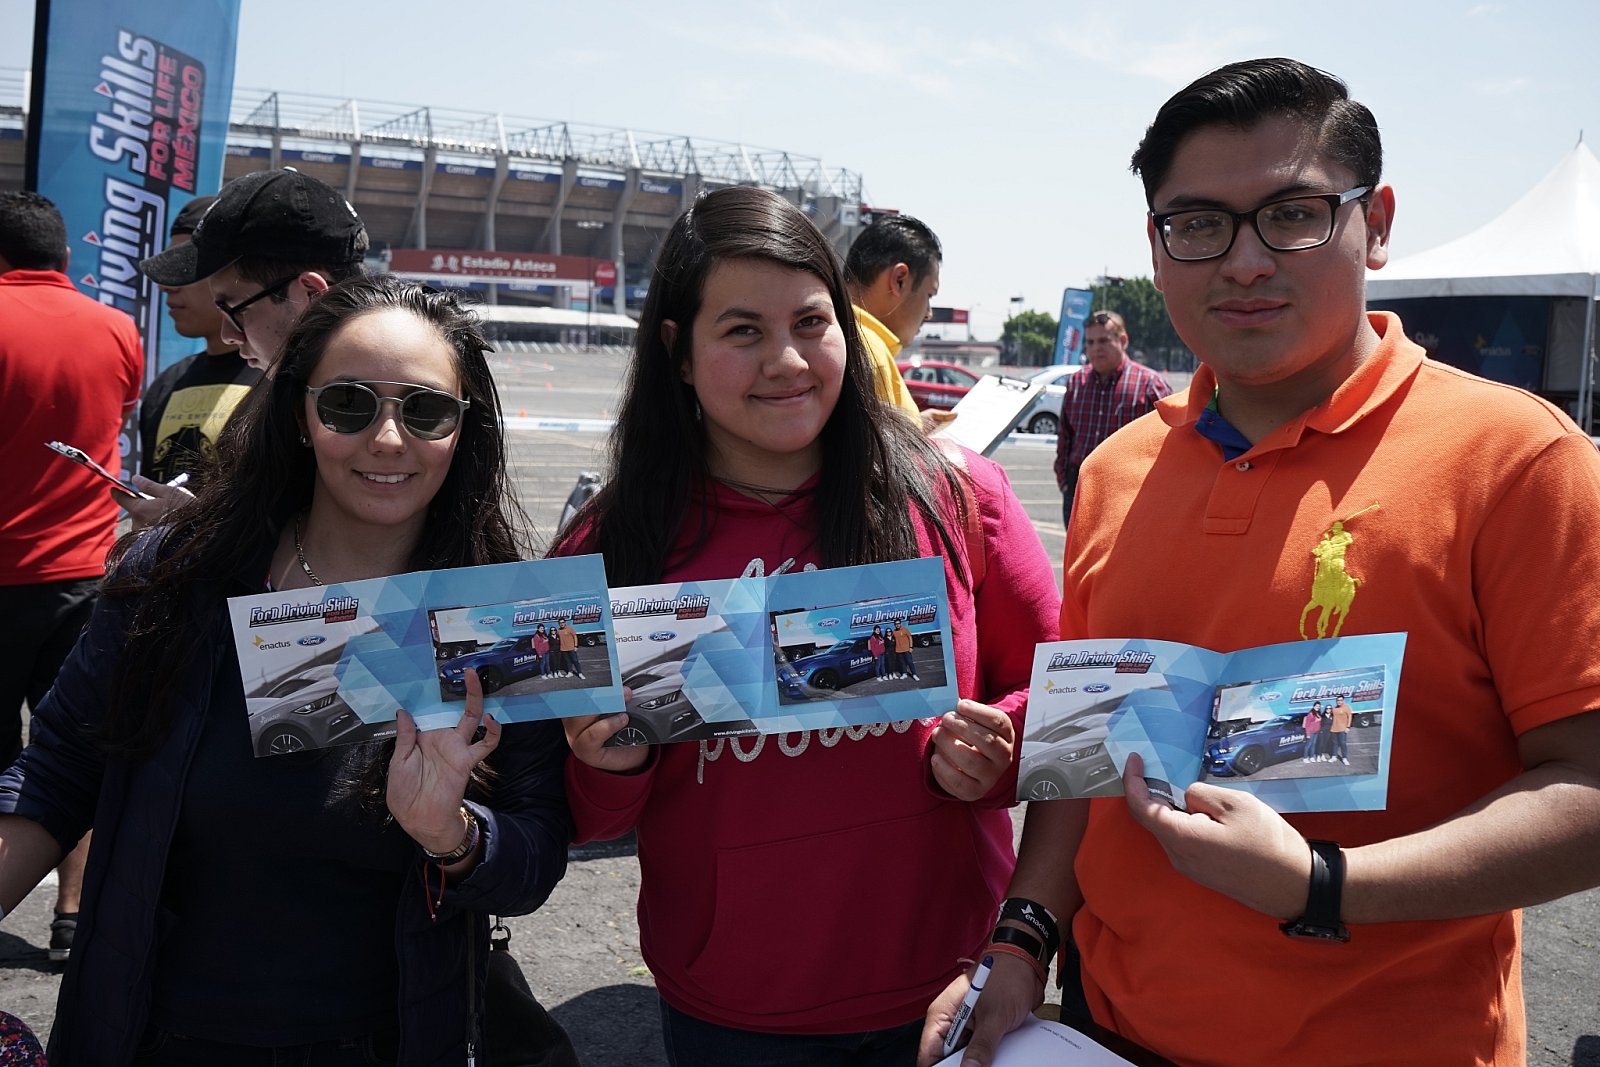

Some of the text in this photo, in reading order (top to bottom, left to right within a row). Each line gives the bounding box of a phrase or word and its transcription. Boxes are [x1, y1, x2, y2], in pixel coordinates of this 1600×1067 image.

[90, 30, 156, 173] Skills
[150, 54, 178, 180] FOR LIFE
[173, 65, 202, 190] MÉXICO
[461, 256, 511, 270] Estadio
[512, 259, 556, 273] Azteca
[281, 602, 325, 619] Driving
[325, 596, 359, 612] Skills
[537, 607, 573, 620] Driving
[575, 604, 602, 615] Skills
[636, 597, 677, 614] Driving
[677, 594, 710, 609] Skills
[875, 609, 909, 621] Driving
[911, 604, 937, 616] Skills
[260, 640, 291, 650] enactus
[302, 636, 321, 645] Ford
[1078, 651, 1119, 667] Driving
[1119, 650, 1156, 663] Skills
[1048, 685, 1077, 694] enactus
[1317, 684, 1355, 697] Driving
[1357, 680, 1385, 692] Skills
[1025, 913, 1049, 939] enactus
